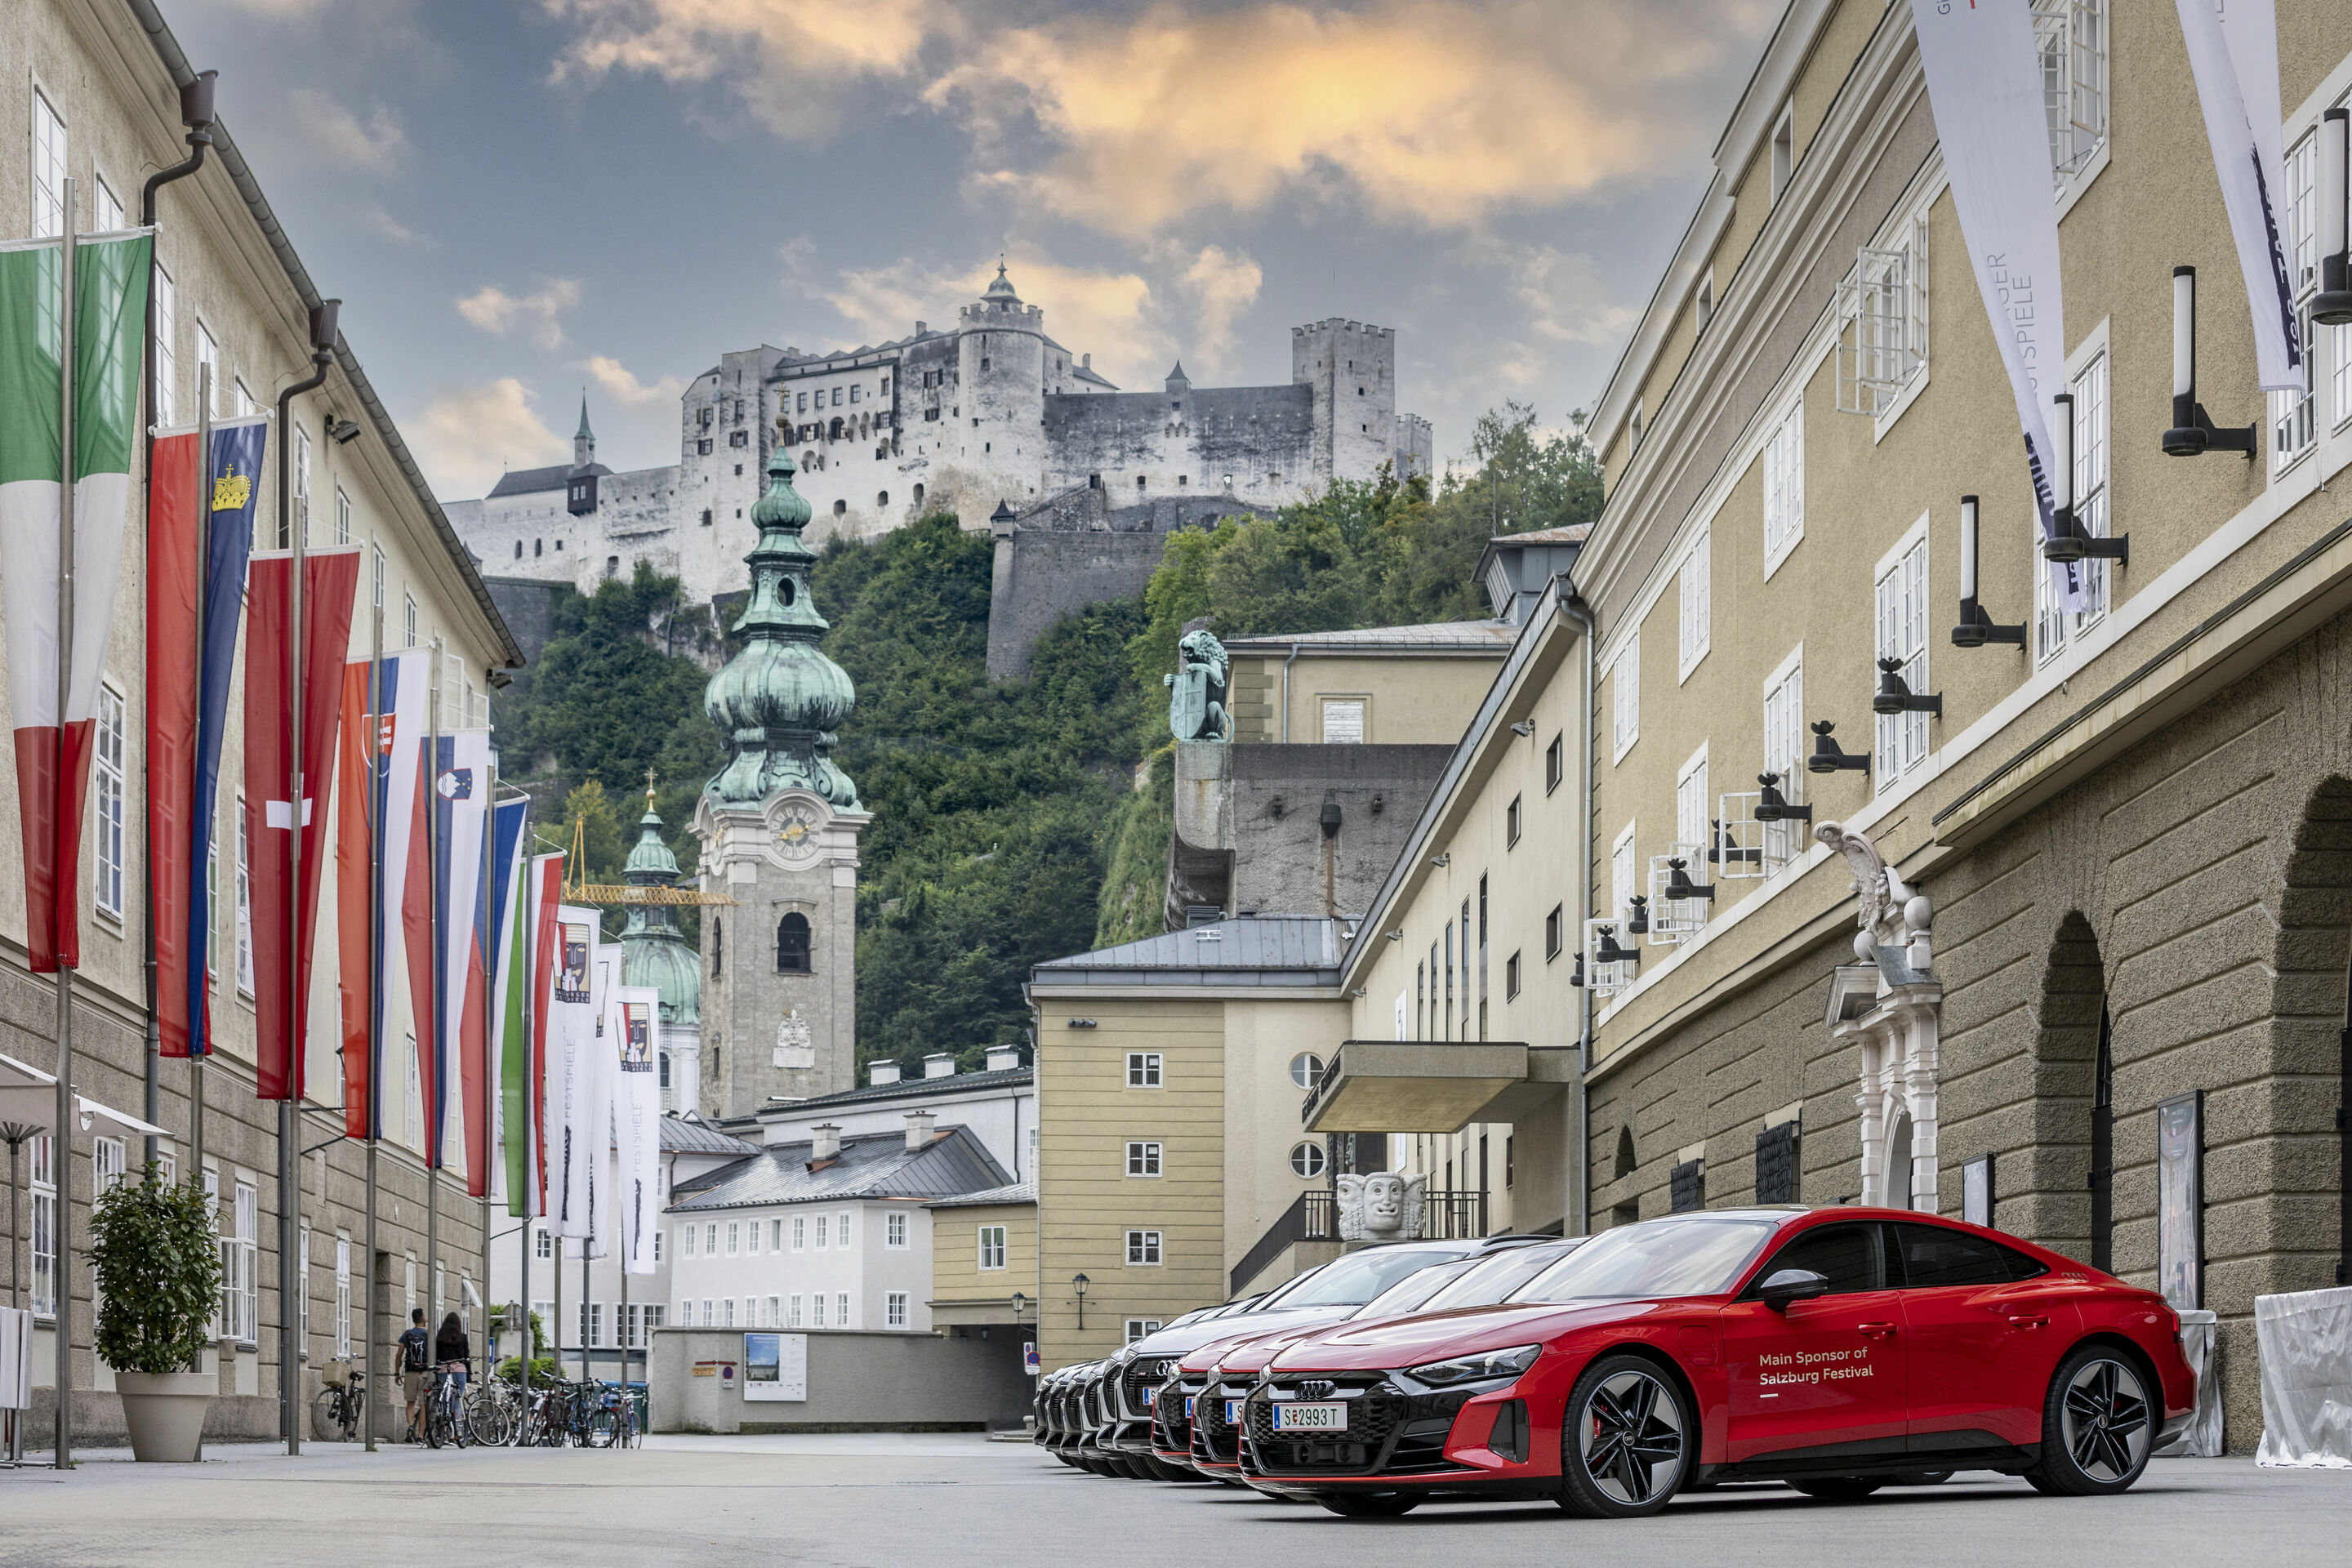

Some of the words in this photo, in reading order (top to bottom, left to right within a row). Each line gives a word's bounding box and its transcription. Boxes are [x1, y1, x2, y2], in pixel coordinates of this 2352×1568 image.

[1759, 1354, 1793, 1366] Main
[1796, 1349, 1851, 1365] Sponsor
[1854, 1346, 1868, 1359] of
[1759, 1371, 1820, 1385] Salzburg
[1823, 1365, 1874, 1380] Festival
